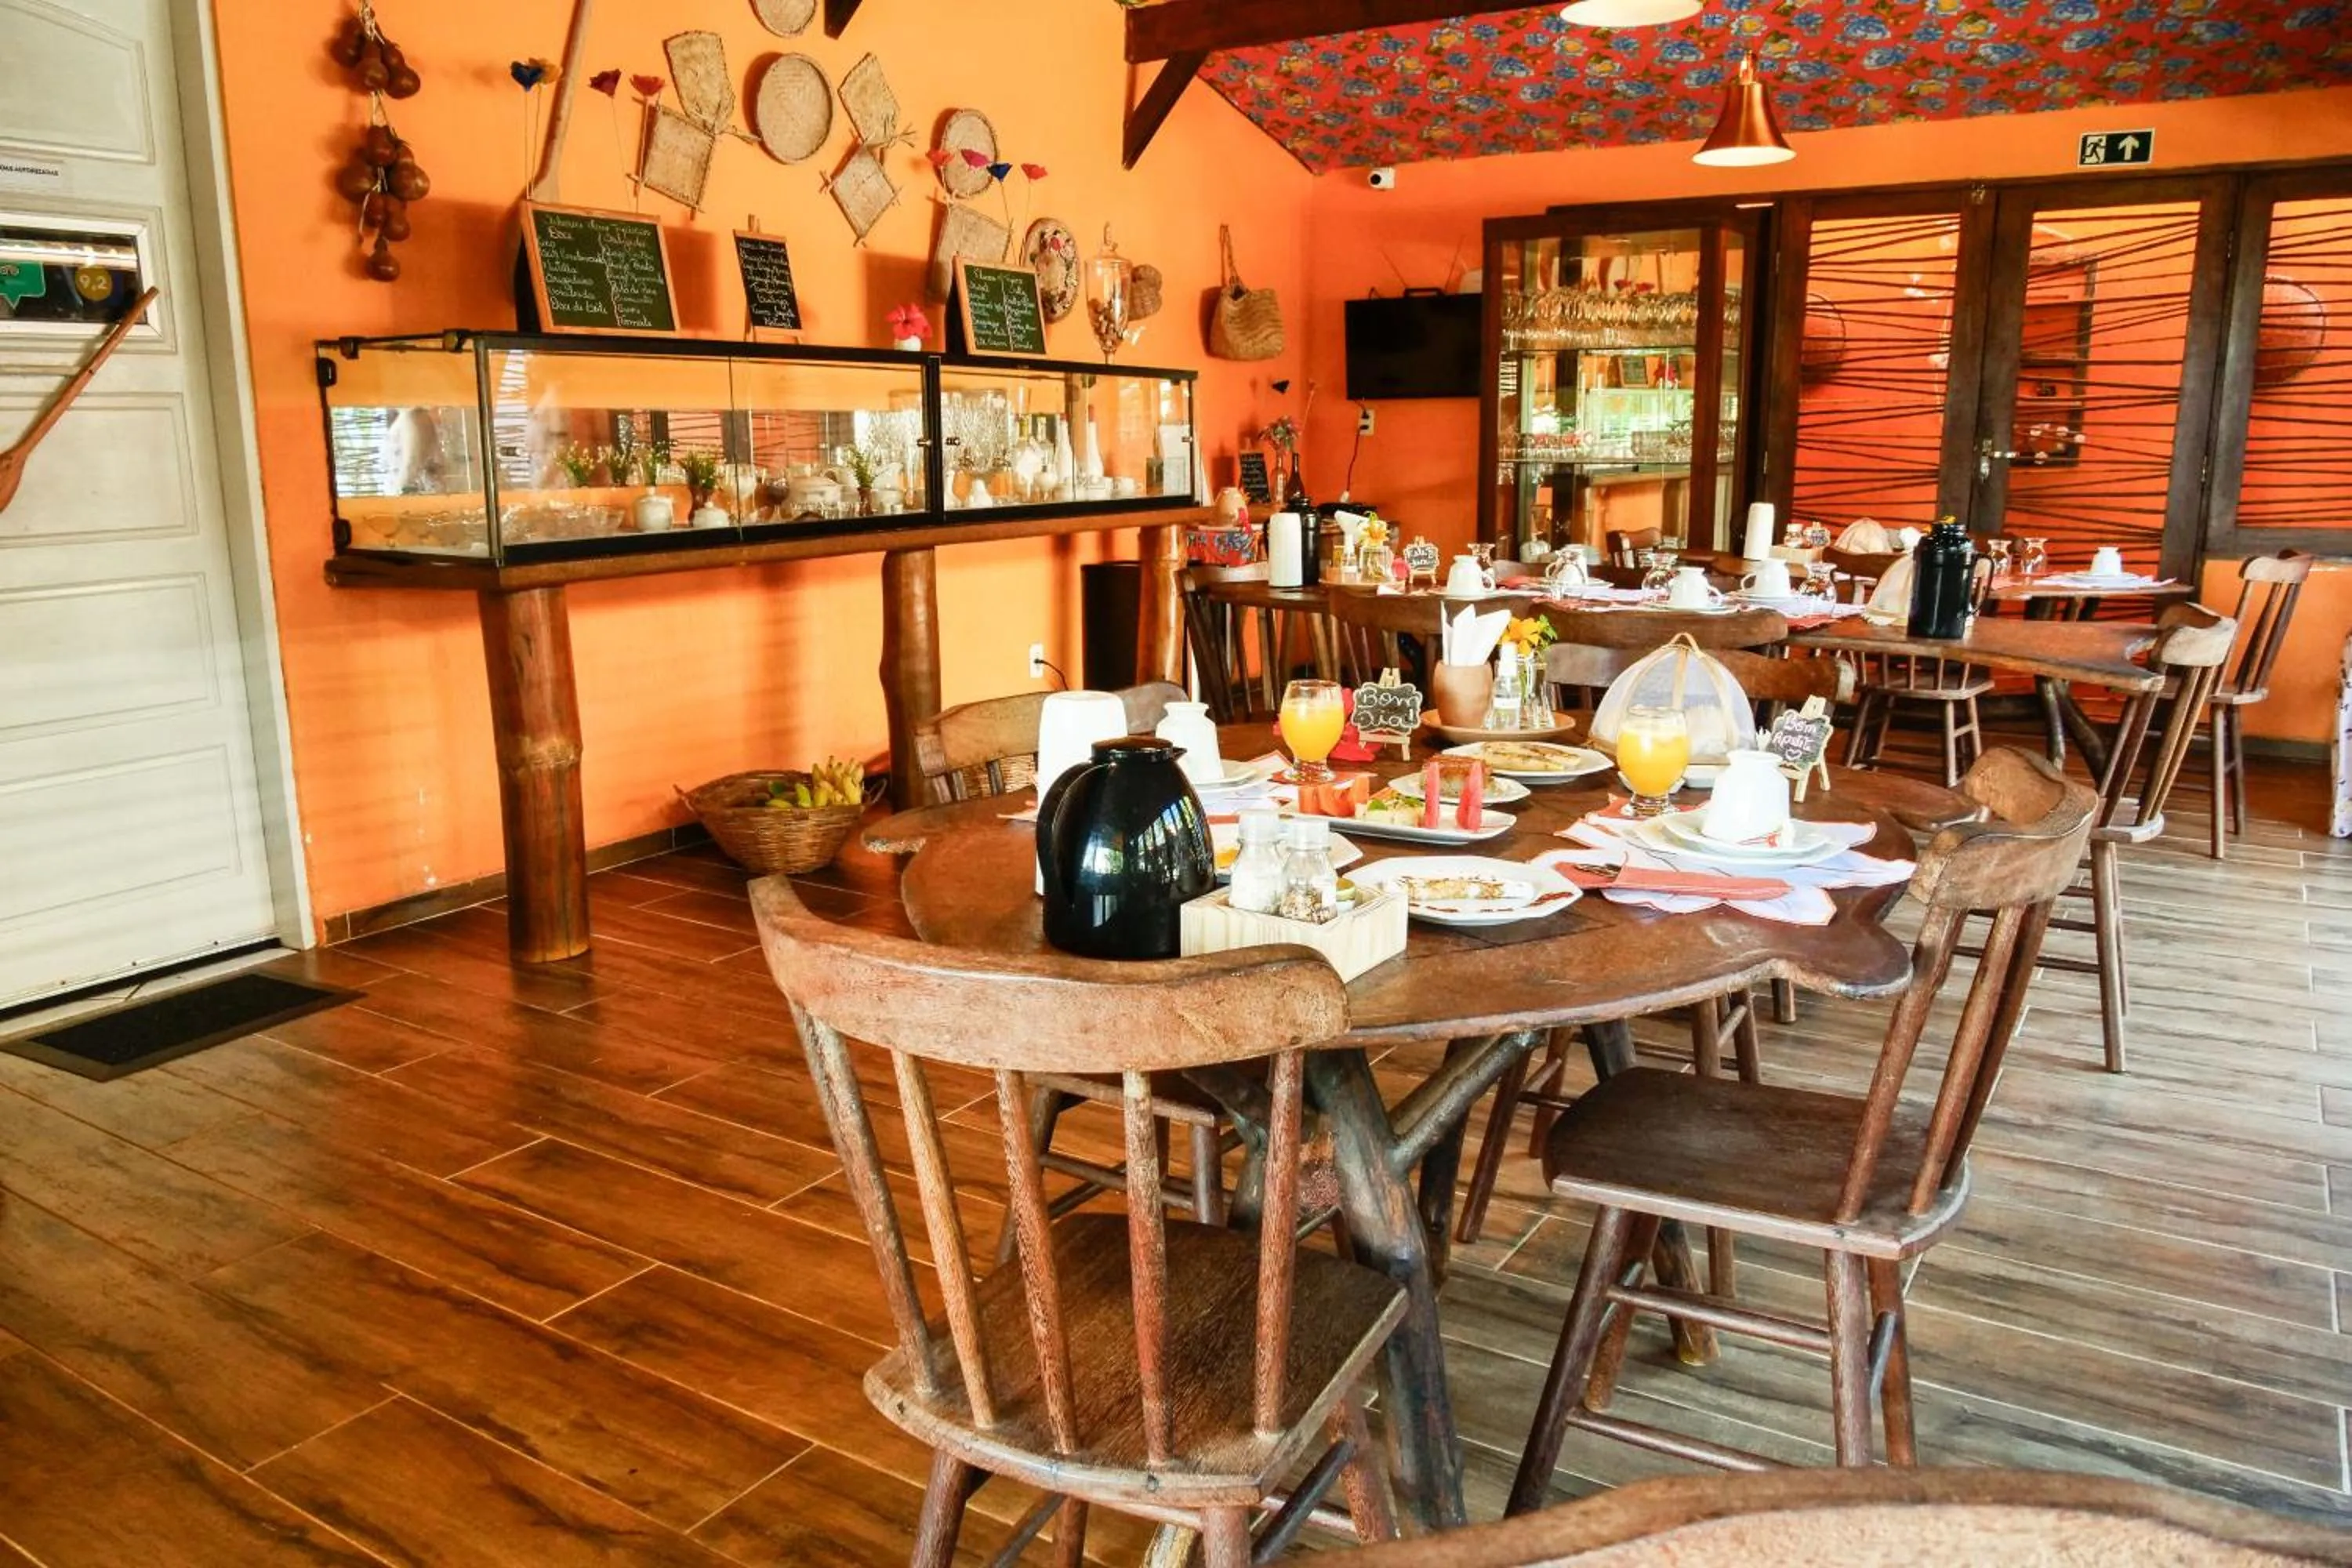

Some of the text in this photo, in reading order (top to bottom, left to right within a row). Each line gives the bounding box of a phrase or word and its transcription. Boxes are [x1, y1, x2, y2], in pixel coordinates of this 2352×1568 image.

[79, 274, 108, 291] 9.2
[1358, 687, 1419, 708] Bom
[1784, 714, 1817, 732] Bom
